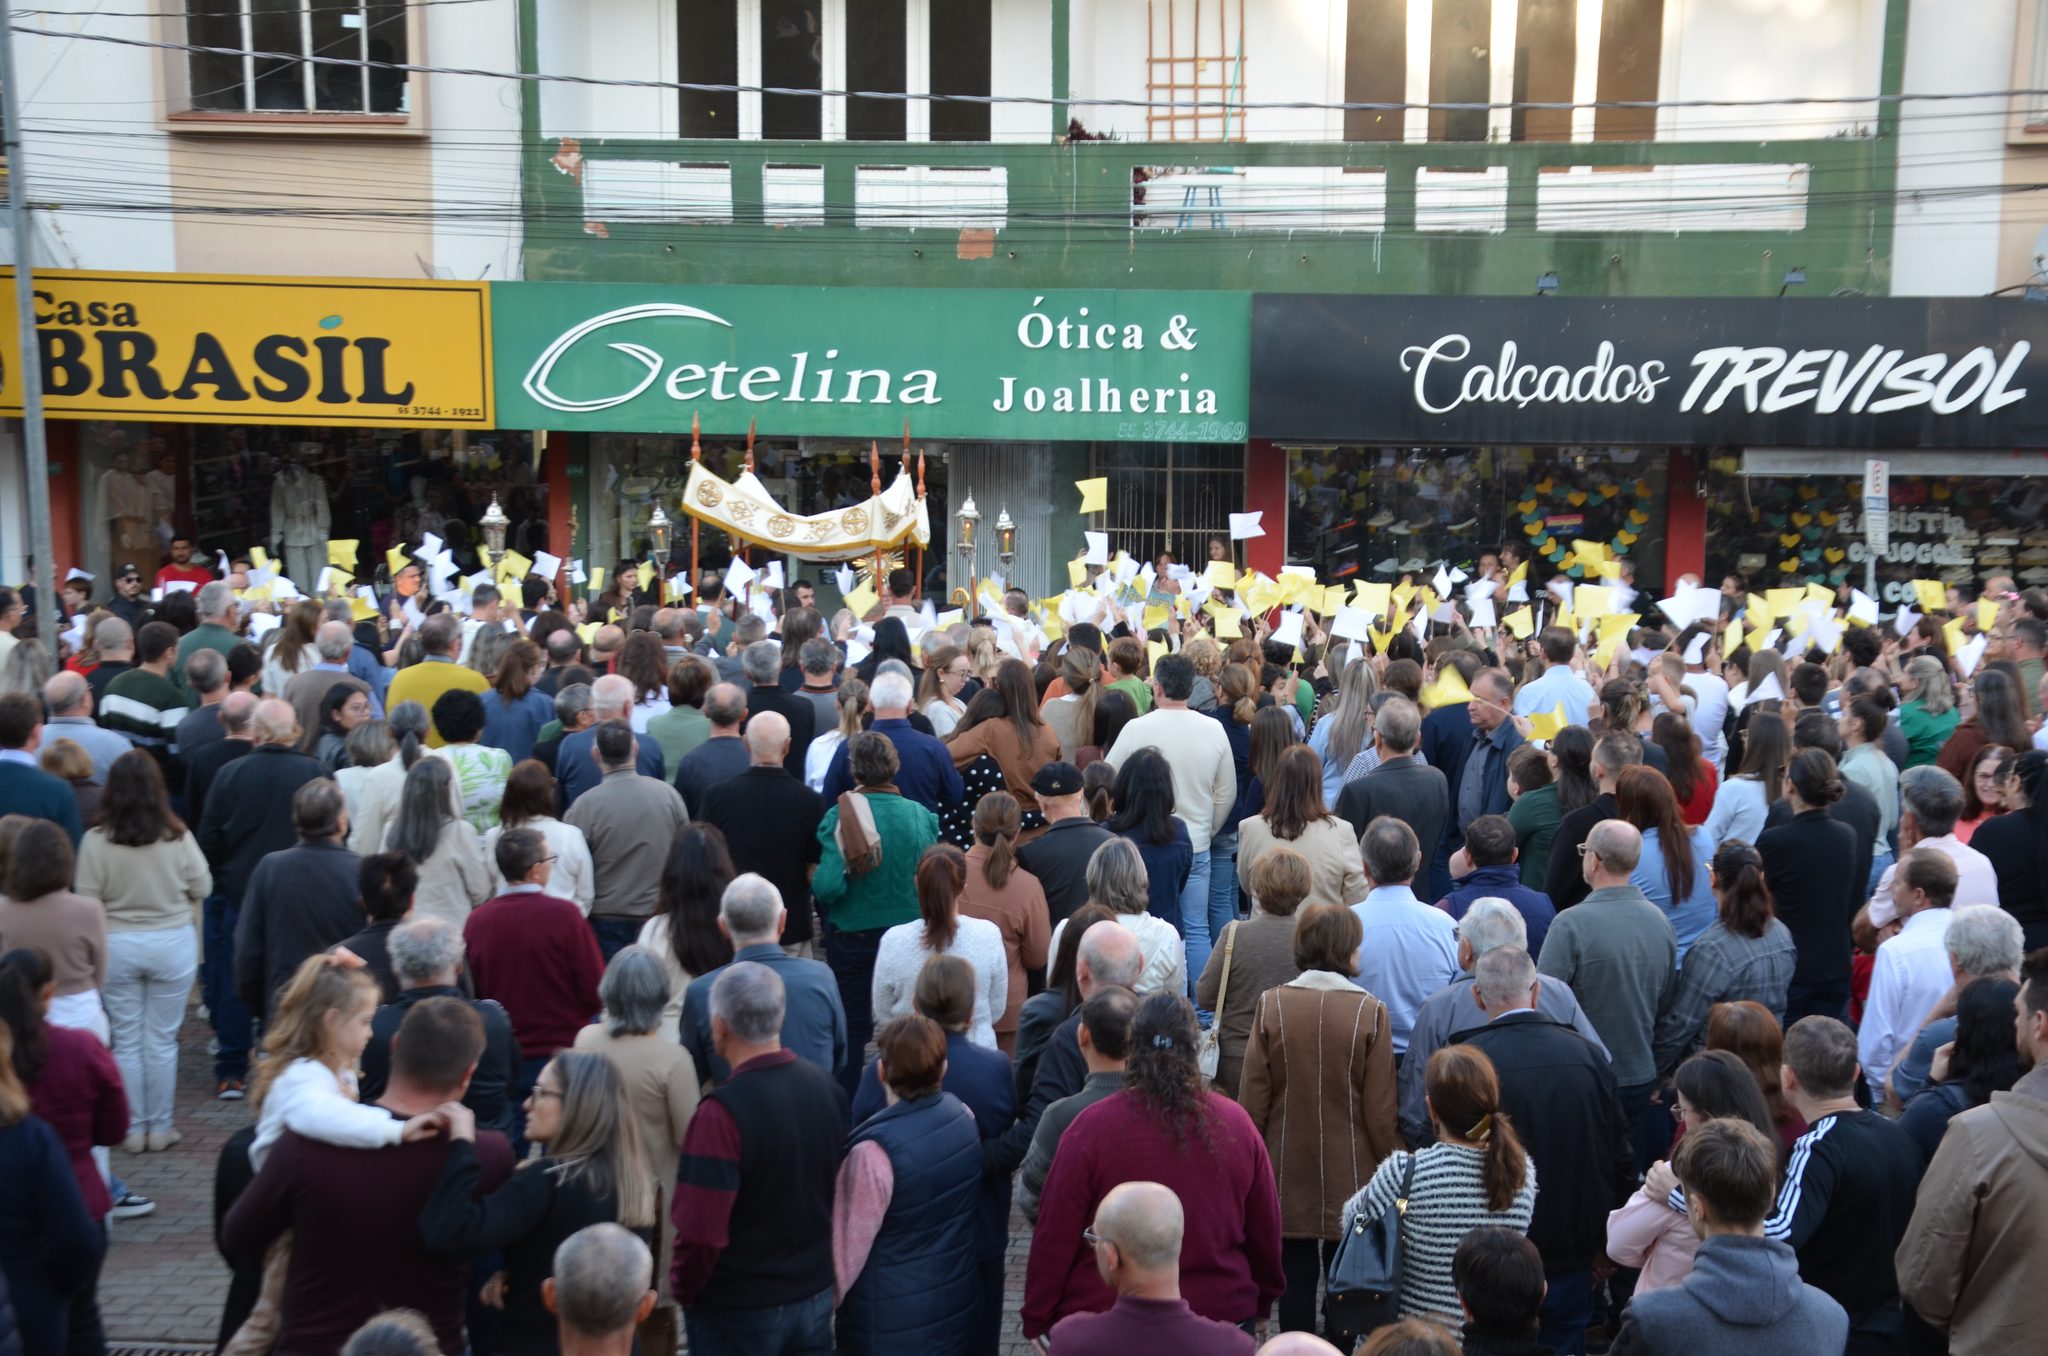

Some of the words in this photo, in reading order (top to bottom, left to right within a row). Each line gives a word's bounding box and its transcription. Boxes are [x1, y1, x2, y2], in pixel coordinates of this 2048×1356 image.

[33, 290, 139, 328] Casa
[1017, 296, 1144, 350] Ótica
[1160, 314, 1198, 351] &
[37, 328, 415, 406] BRASIL
[1400, 333, 1671, 414] Calçados
[1679, 339, 2031, 415] TREVISOL
[412, 407, 441, 415] 3744
[452, 408, 480, 416] 1922
[992, 372, 1218, 415] Joalheria
[1117, 422, 1137, 438] 55
[1142, 420, 1247, 441] 3744-1969
